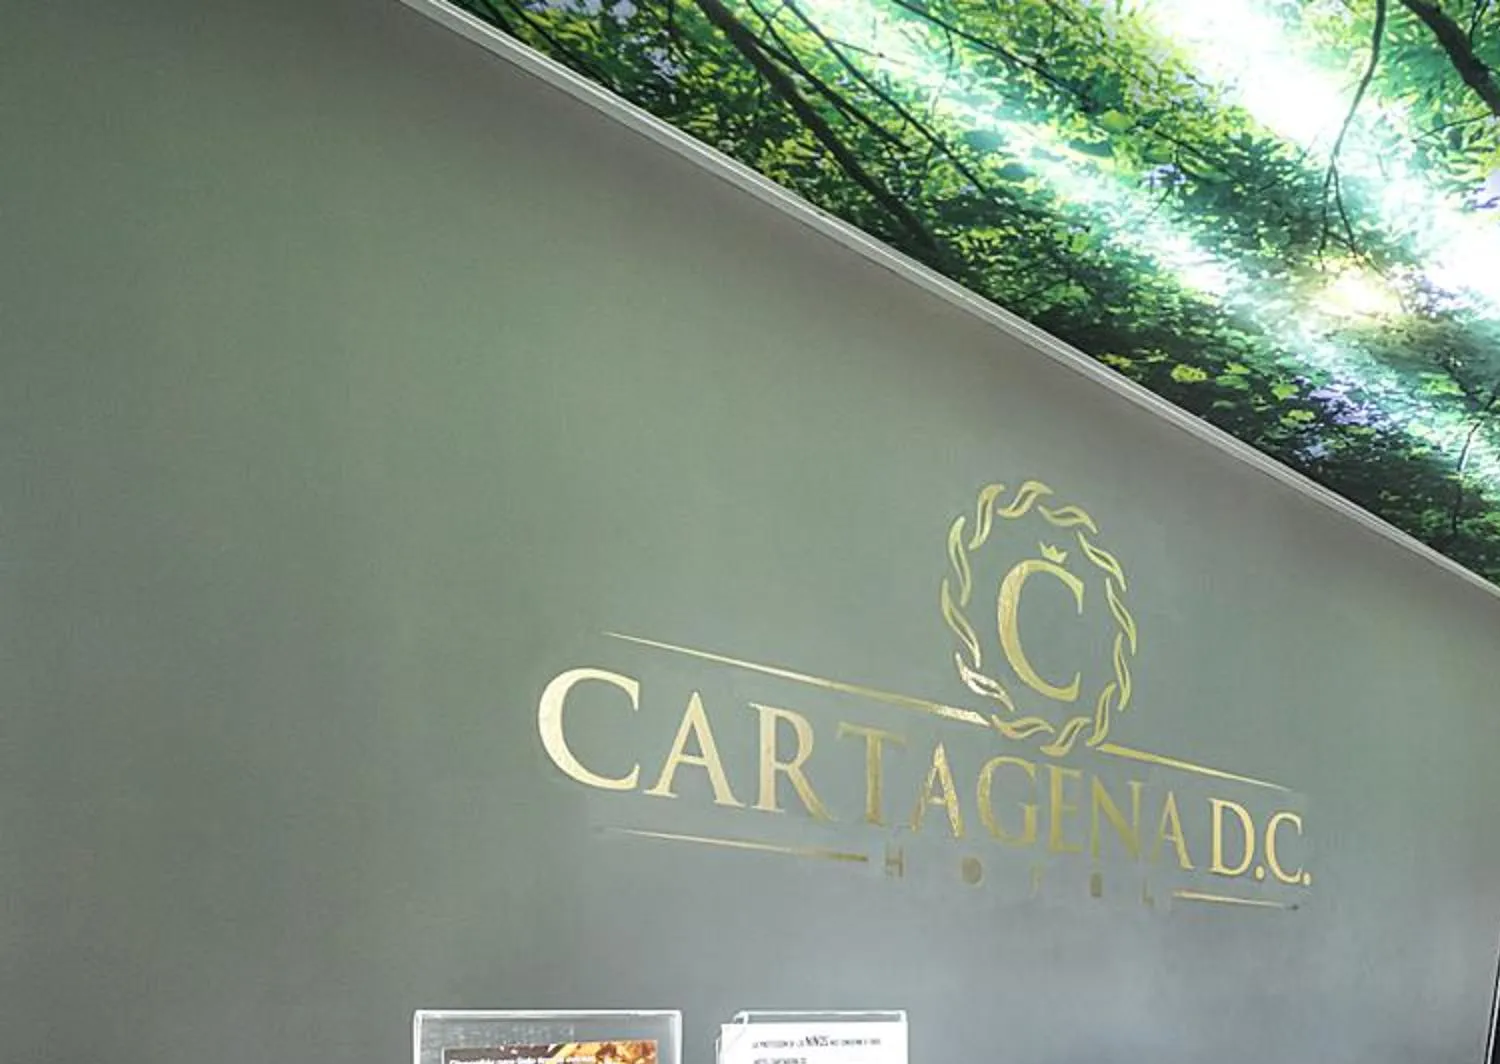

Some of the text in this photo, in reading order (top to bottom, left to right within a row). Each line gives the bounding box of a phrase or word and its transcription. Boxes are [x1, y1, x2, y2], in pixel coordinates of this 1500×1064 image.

[997, 557, 1085, 703] C
[537, 666, 1312, 886] CARTAGENA D.C.
